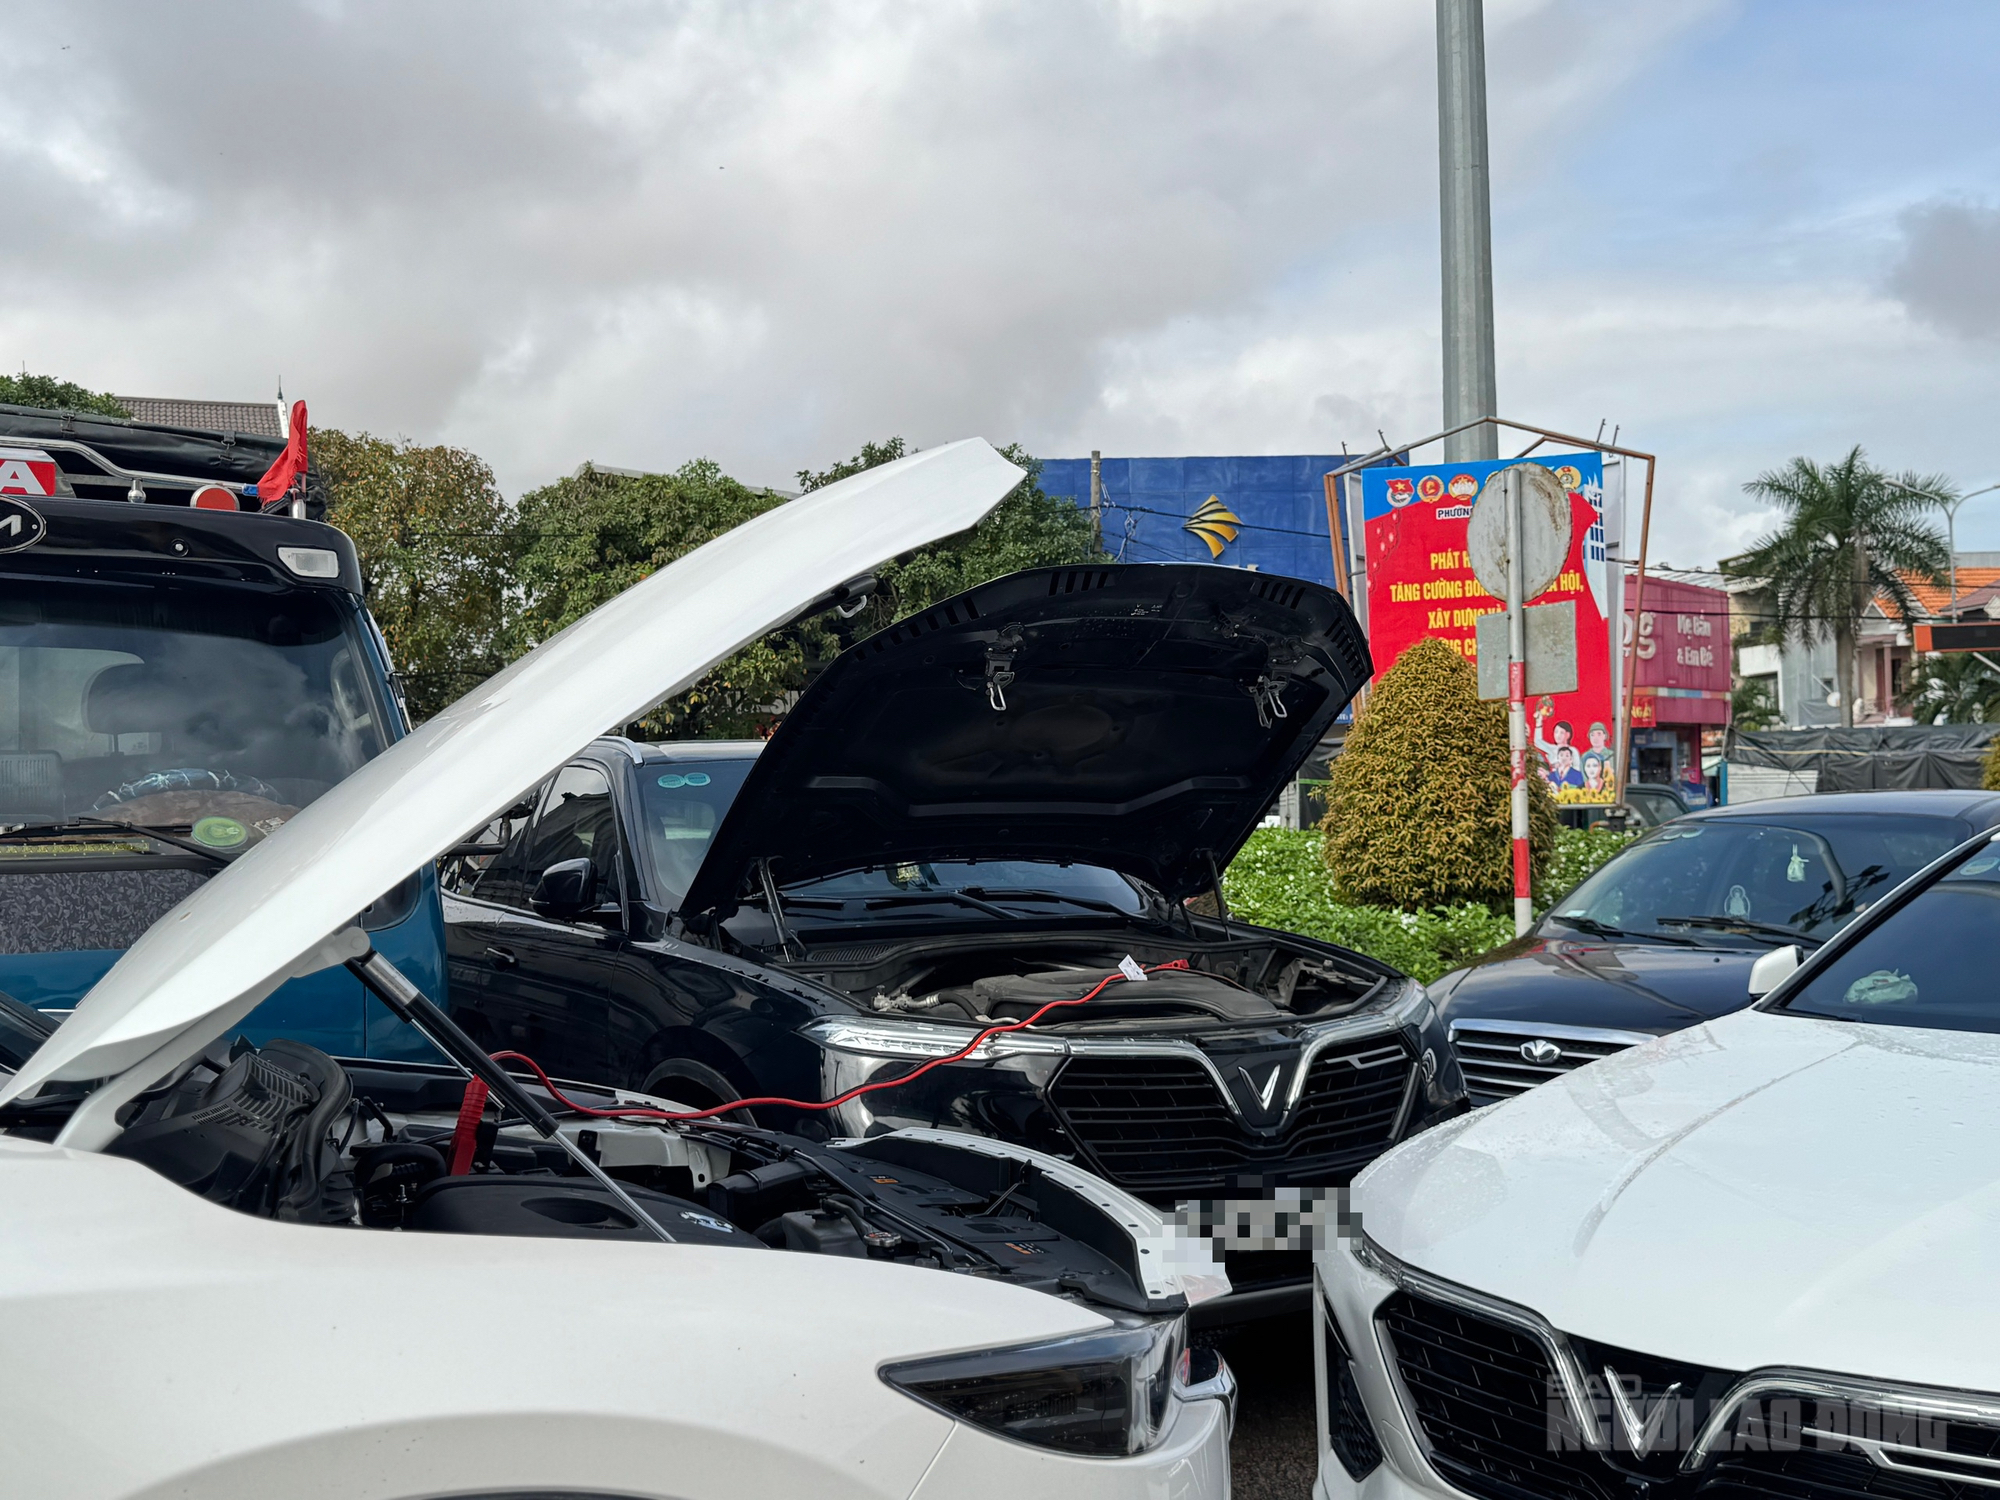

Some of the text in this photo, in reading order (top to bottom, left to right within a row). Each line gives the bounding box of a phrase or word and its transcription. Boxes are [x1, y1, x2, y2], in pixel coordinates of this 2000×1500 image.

[1430, 548, 1460, 570] PHÁT
[1389, 581, 1421, 602] TĂNG
[1423, 577, 1463, 600] CƯỜNG
[1559, 569, 1584, 595] HỘI,
[1427, 606, 1450, 630] XÂY
[1677, 647, 1684, 665] &
[1684, 646, 1700, 666] Em
